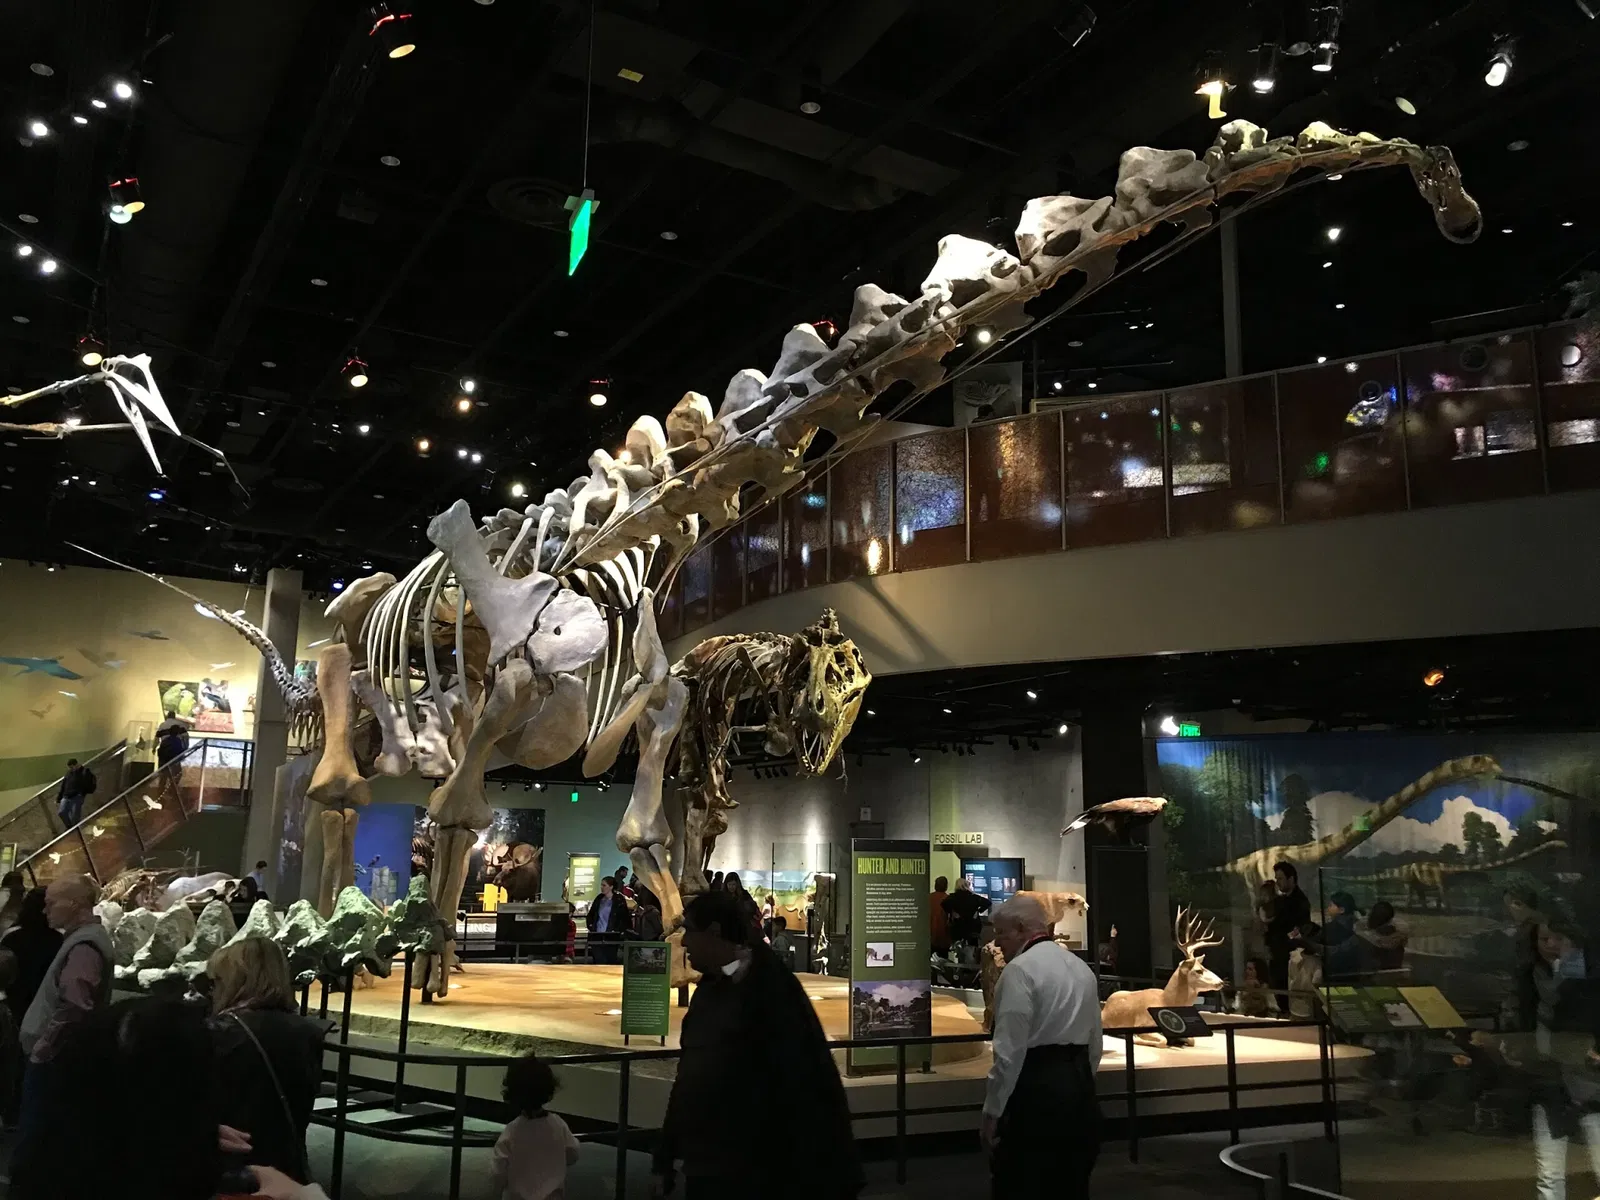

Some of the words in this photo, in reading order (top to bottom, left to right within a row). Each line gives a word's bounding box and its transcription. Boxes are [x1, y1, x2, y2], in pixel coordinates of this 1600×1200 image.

[935, 834, 963, 844] FOSSIL
[965, 834, 982, 844] LAB
[857, 858, 884, 875] HUNTER
[885, 858, 899, 875] AND
[900, 859, 926, 875] HUNTED
